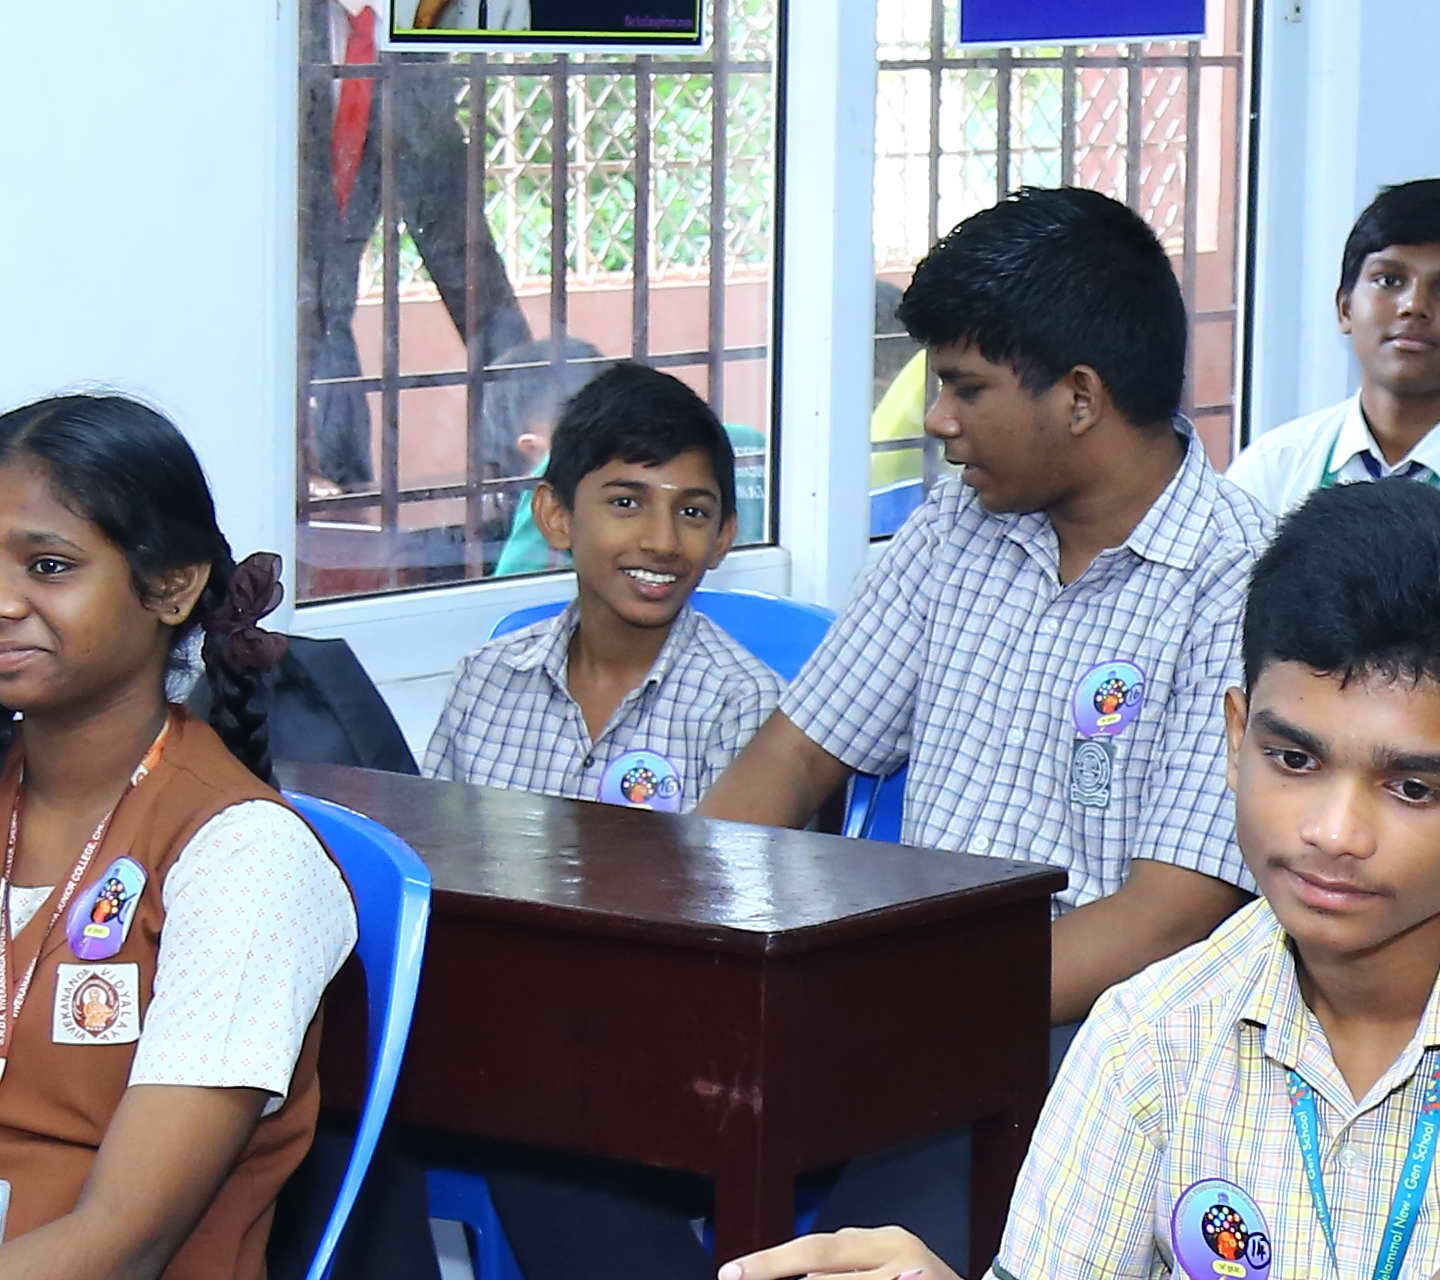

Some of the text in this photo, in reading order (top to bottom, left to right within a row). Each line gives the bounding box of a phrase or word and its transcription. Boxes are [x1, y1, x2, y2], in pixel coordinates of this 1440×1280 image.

[60, 967, 132, 1041] VIVEKANANDA VIDYALAYA
[1296, 1111, 1312, 1151] School
[1395, 1203, 1411, 1229] New
[1404, 1165, 1422, 1190] Gen
[1413, 1121, 1436, 1162] School
